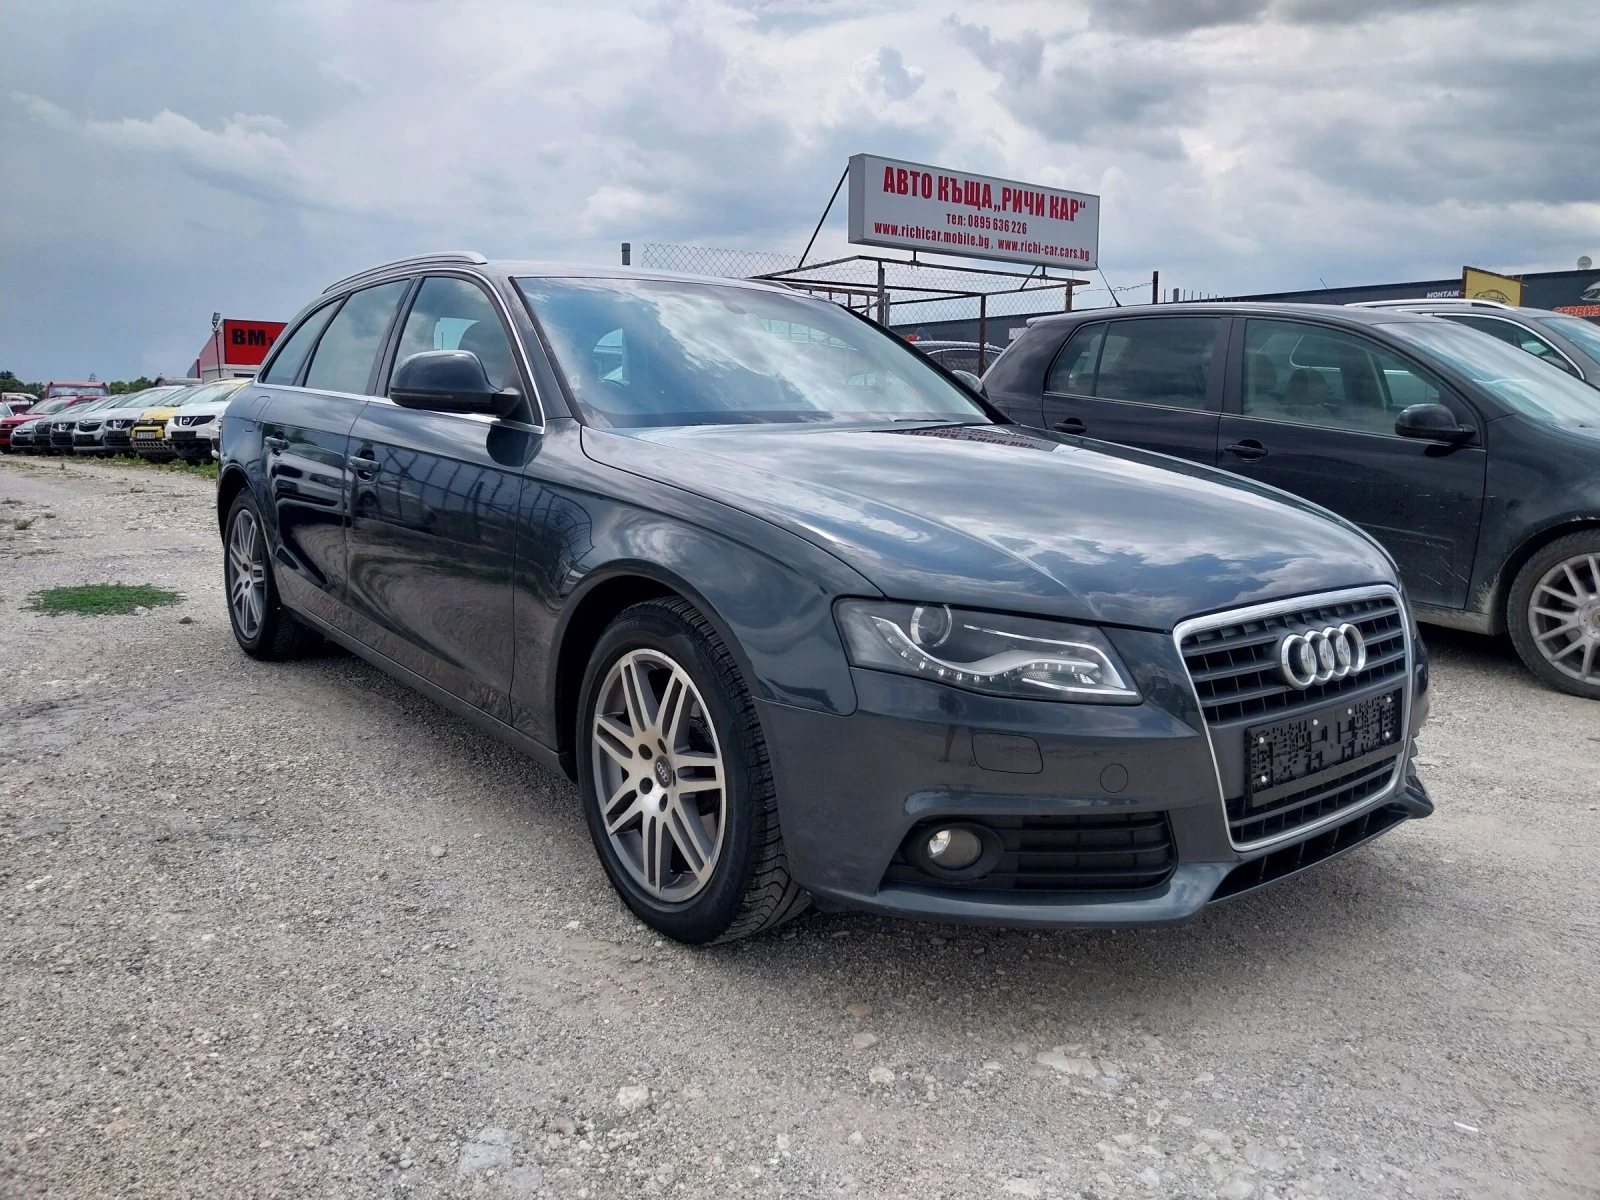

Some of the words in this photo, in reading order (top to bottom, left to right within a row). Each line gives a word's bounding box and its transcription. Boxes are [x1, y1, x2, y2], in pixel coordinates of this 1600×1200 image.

[883, 166, 933, 199] АВТО
[937, 175, 992, 211] КЪЩА
[968, 214, 991, 230] 0895
[992, 218, 1010, 232] 636
[1011, 221, 1027, 235] 226
[997, 238, 1090, 261] www.richi-car.cars.bg
